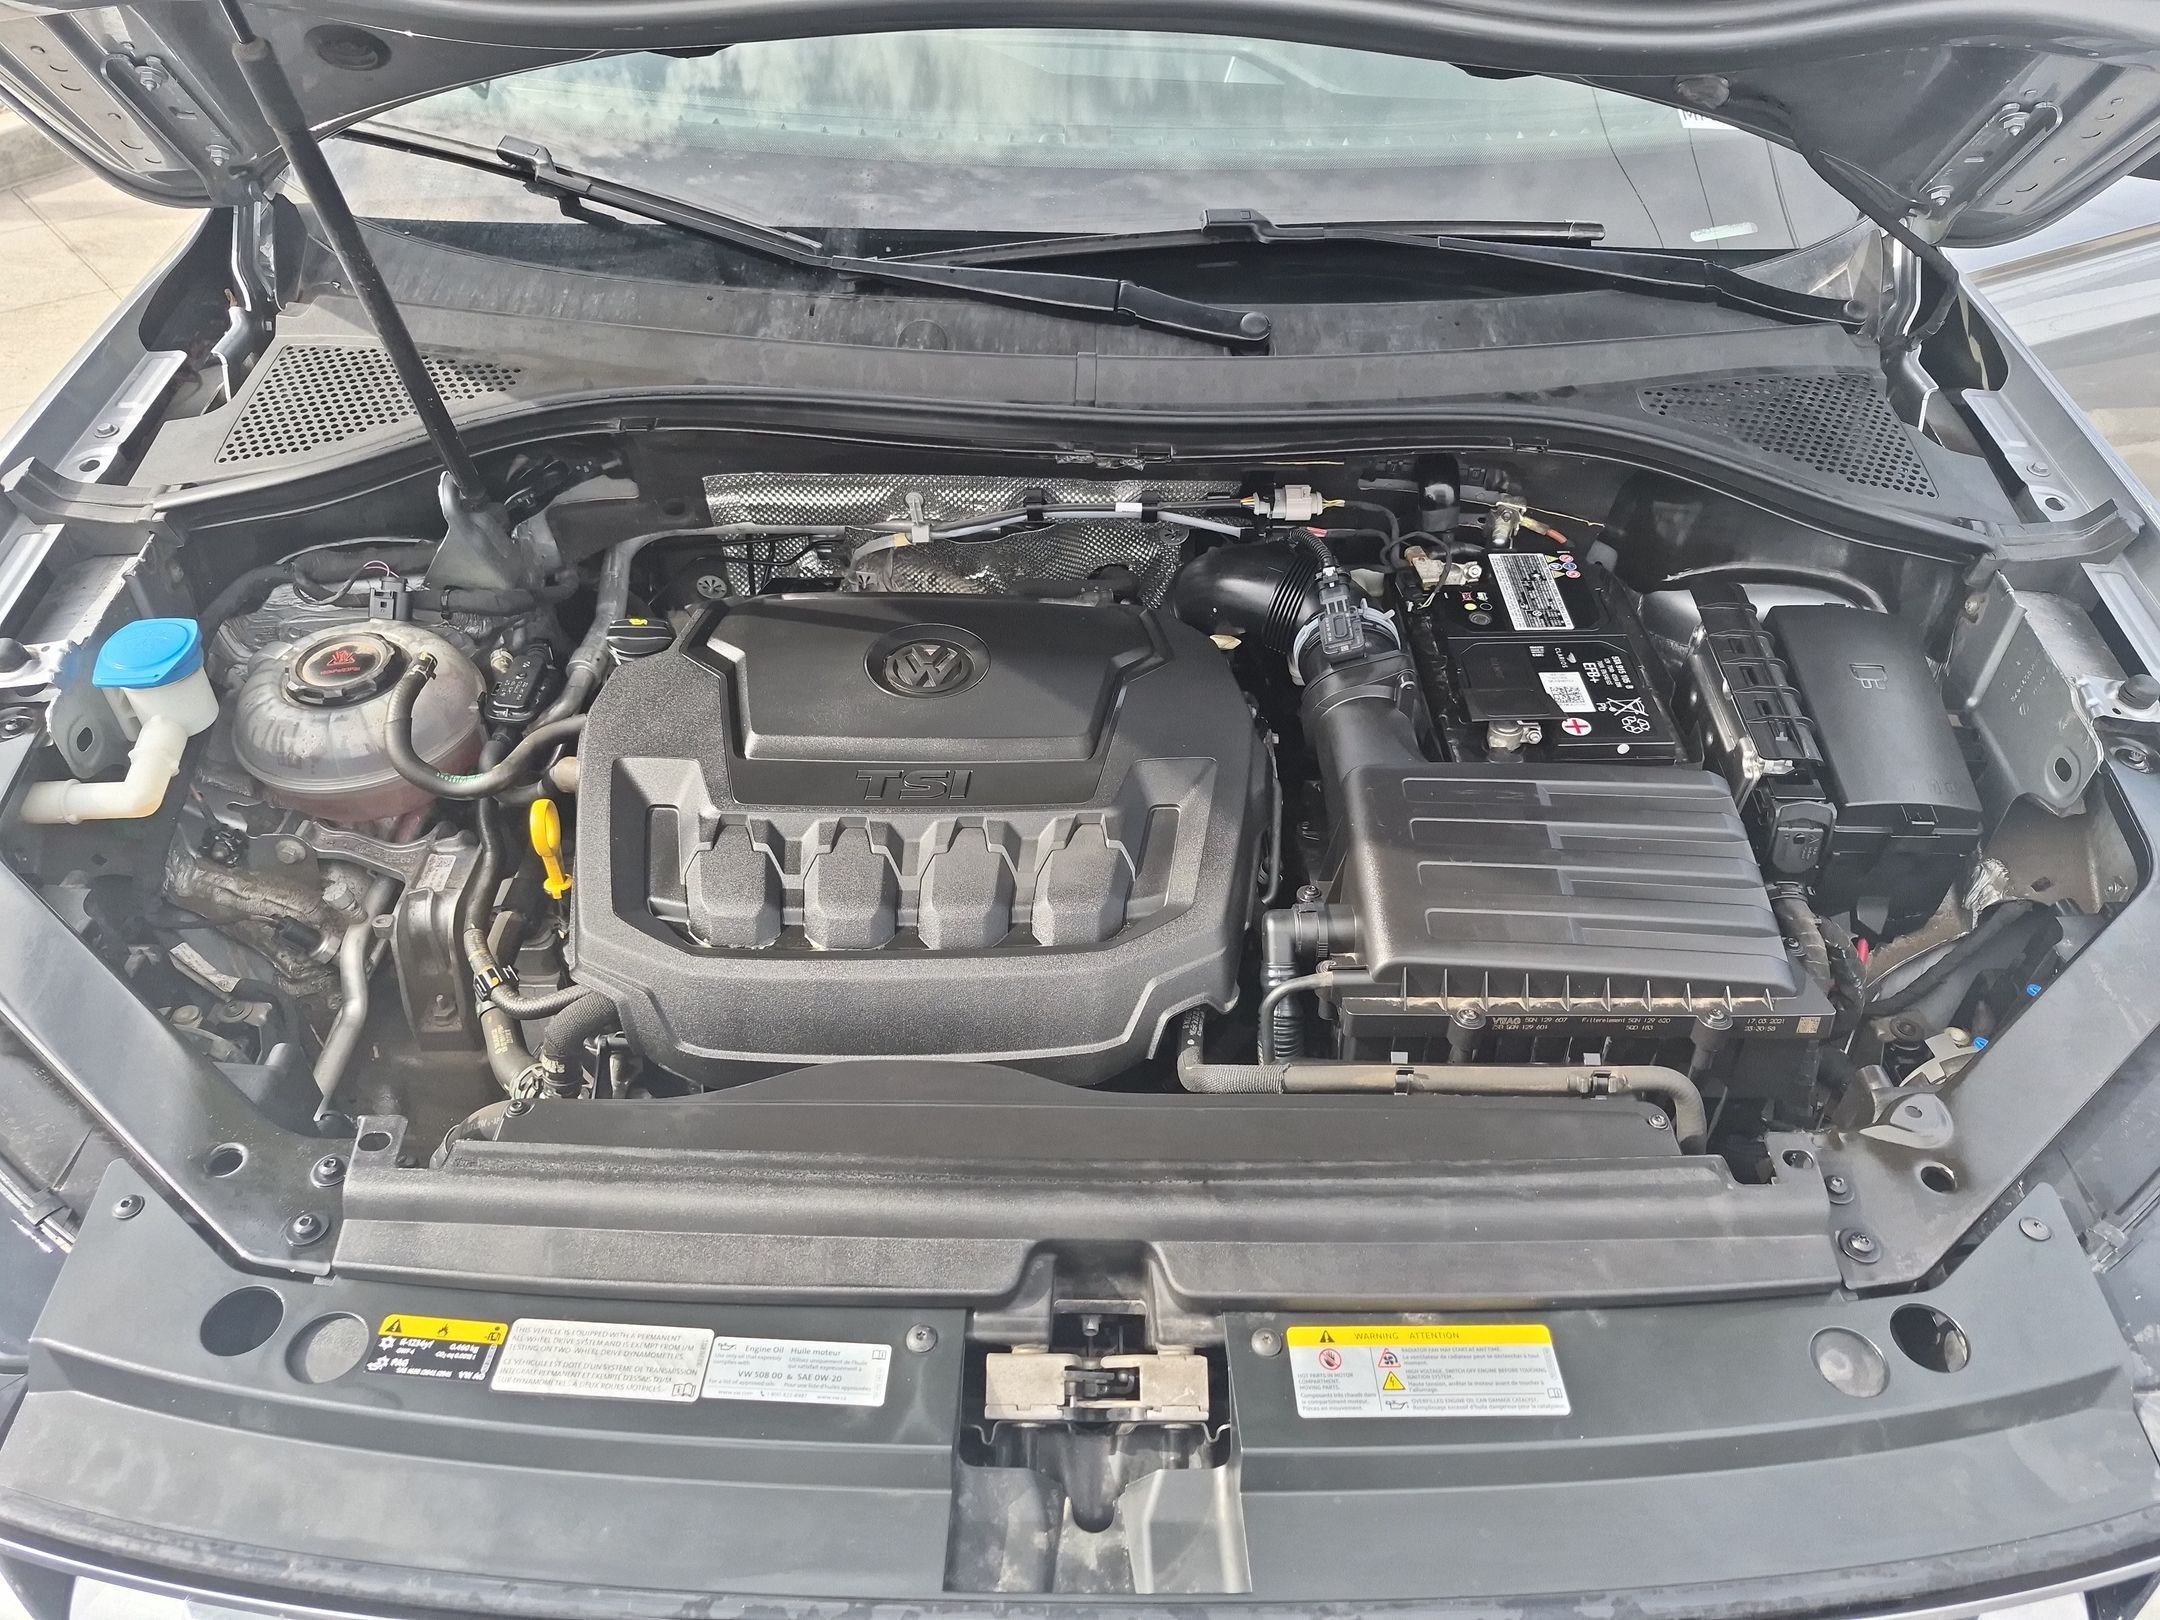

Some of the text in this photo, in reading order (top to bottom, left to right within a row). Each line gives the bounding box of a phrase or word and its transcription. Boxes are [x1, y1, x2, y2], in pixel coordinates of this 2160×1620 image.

[1554, 647, 1568, 669] CLARIOS
[1582, 662, 1601, 684] EFB+
[1596, 702, 1608, 712] Pb
[856, 769, 973, 800] TSI
[571, 1329, 609, 1338] EQUIPPED
[637, 1333, 681, 1341] PERMANENT
[1354, 1332, 1460, 1340] WARNING ATTENTION
[399, 1338, 436, 1350] R-1234yf
[553, 1337, 574, 1345] DRIVE
[576, 1338, 605, 1346] SYSTEM
[630, 1342, 658, 1350] EXEMPT
[509, 1344, 539, 1352] TESTING
[601, 1349, 621, 1357] DRIVE
[745, 1345, 771, 1354] Engine
[791, 1347, 811, 1355] Huile
[390, 1358, 410, 1367] PAG
[458, 1371, 472, 1379] VW
[646, 1367, 698, 1376] TRANSMISSION
[814, 1374, 842, 1382] 0W-20
